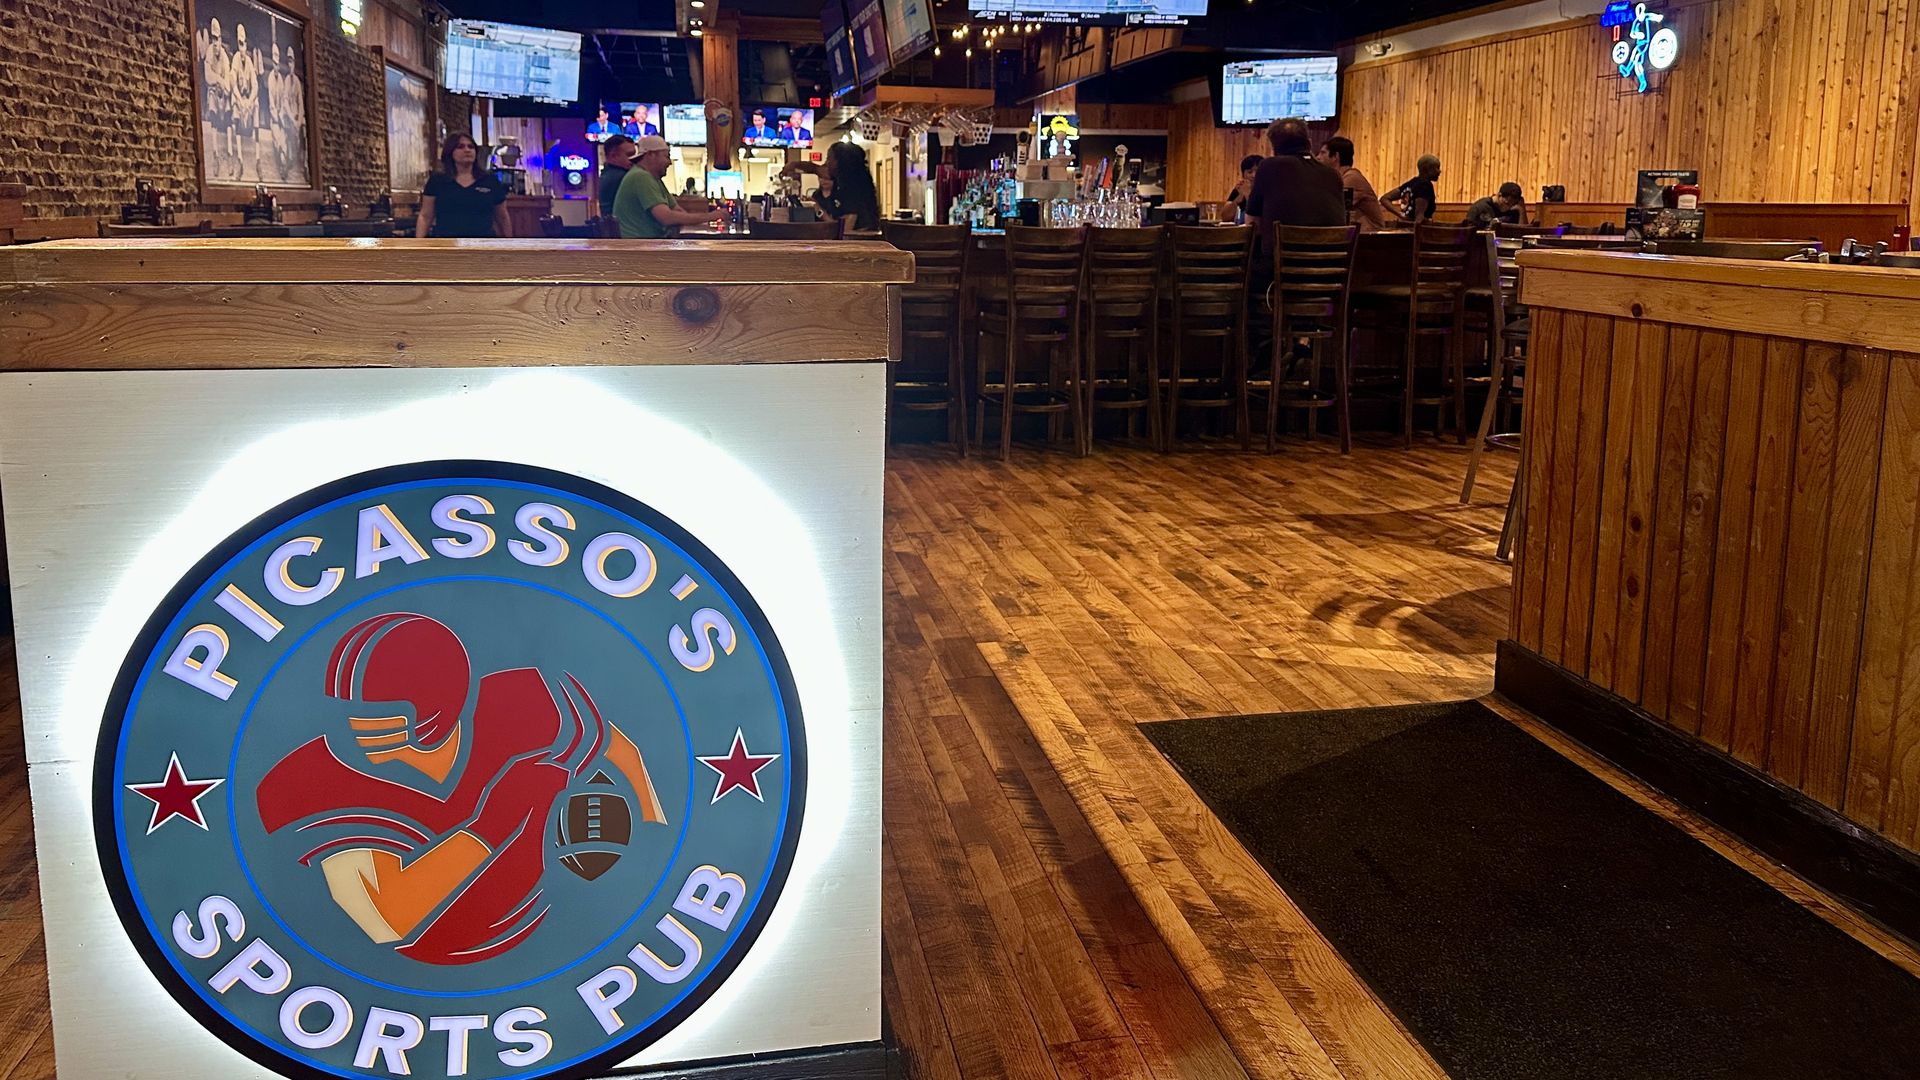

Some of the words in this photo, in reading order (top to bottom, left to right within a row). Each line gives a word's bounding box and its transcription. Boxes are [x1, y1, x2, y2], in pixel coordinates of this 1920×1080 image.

[163, 494, 738, 701] PICASSO'S
[172, 894, 554, 1077] SPORTS
[576, 863, 747, 1037] PUB
